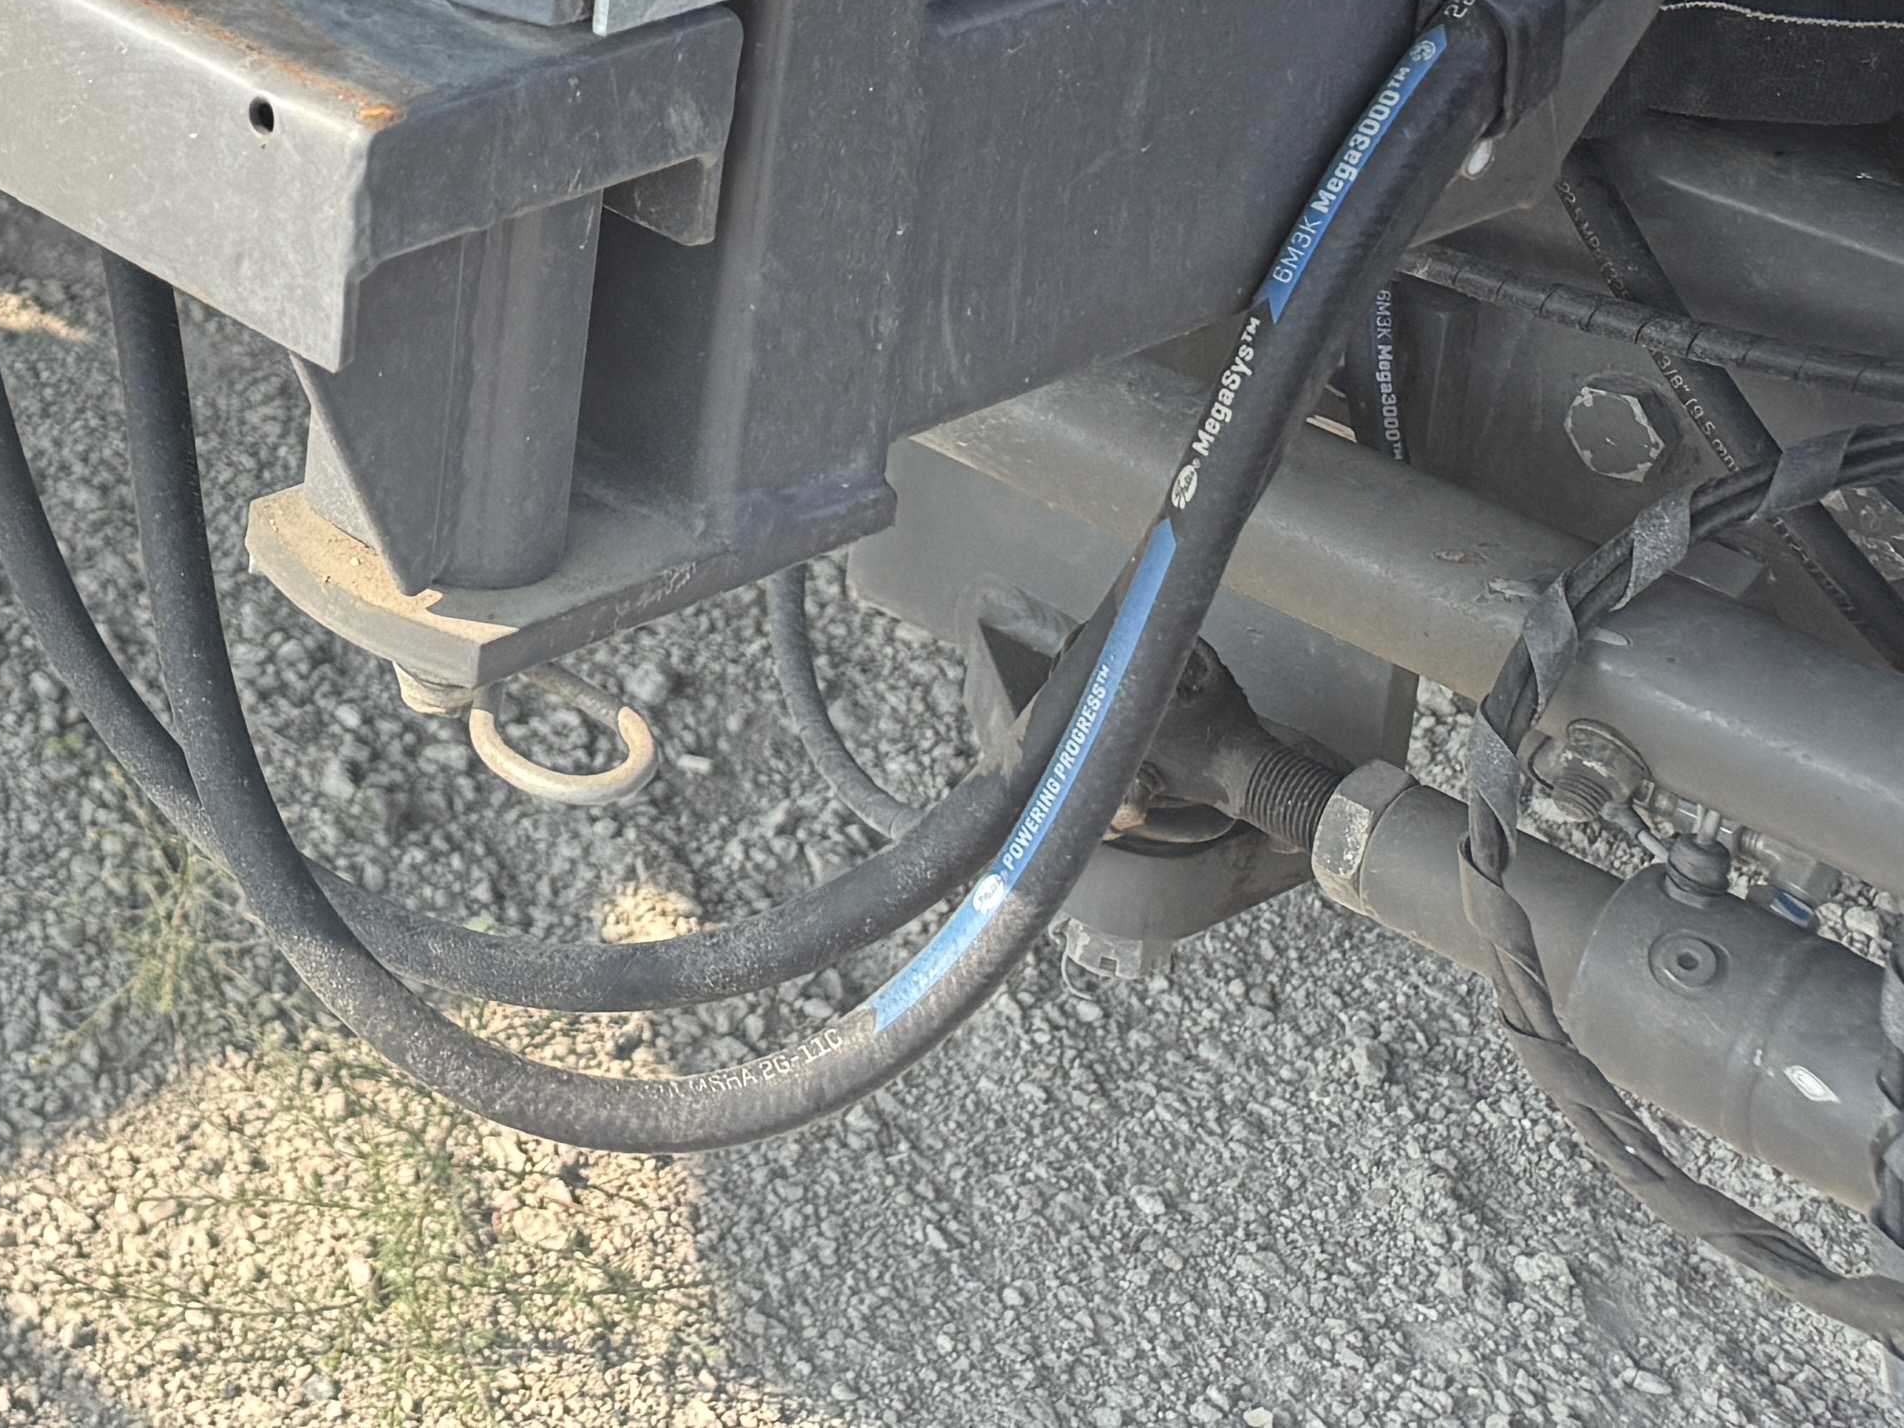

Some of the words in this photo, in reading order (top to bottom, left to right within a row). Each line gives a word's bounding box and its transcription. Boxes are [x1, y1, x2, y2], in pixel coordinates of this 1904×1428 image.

[1272, 215, 1323, 285] 6M3K
[1376, 289, 1392, 340] 6M3K
[1002, 772, 1060, 871] POWERING
[761, 1028, 844, 1078] 2G-11C
